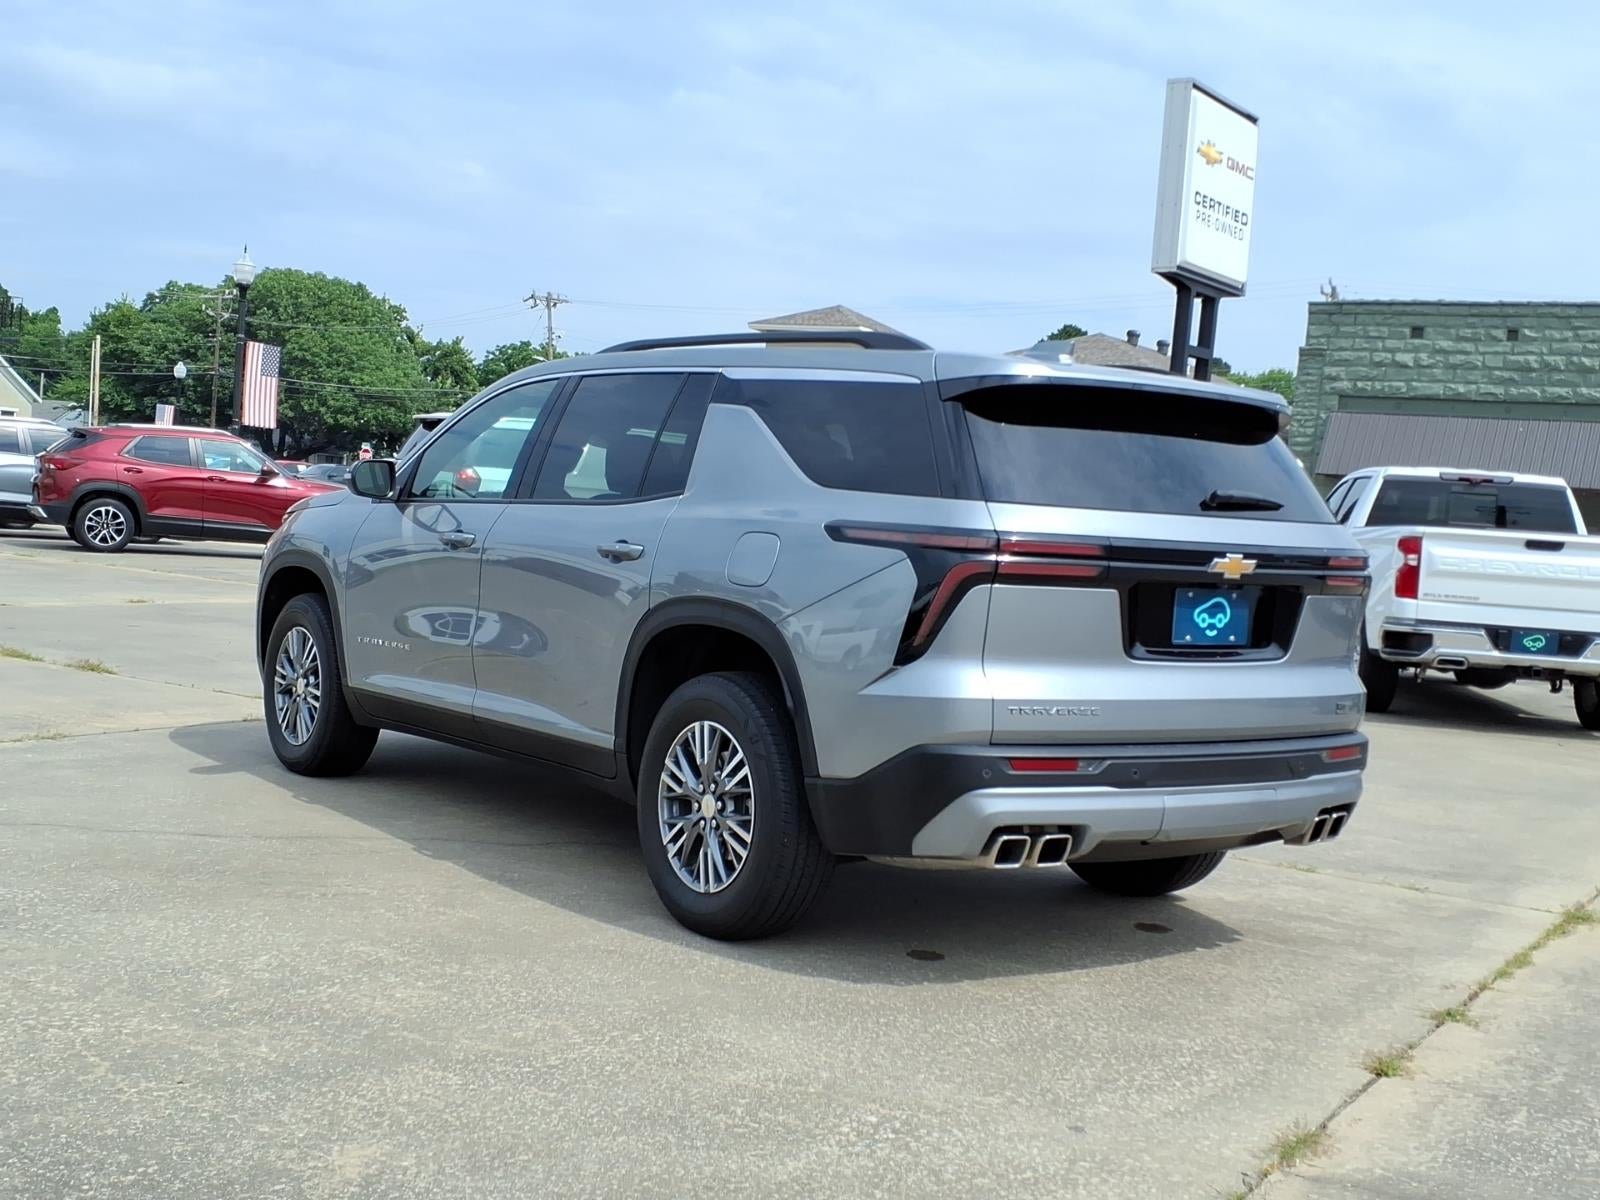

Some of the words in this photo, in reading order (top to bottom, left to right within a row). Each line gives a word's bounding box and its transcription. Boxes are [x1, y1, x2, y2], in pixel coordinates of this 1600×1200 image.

[1226, 157, 1254, 181] GMC
[1194, 191, 1249, 227] CERTIFIED
[1196, 209, 1244, 241] PRE-OWNED
[1007, 706, 1101, 717] TRAVERSE
